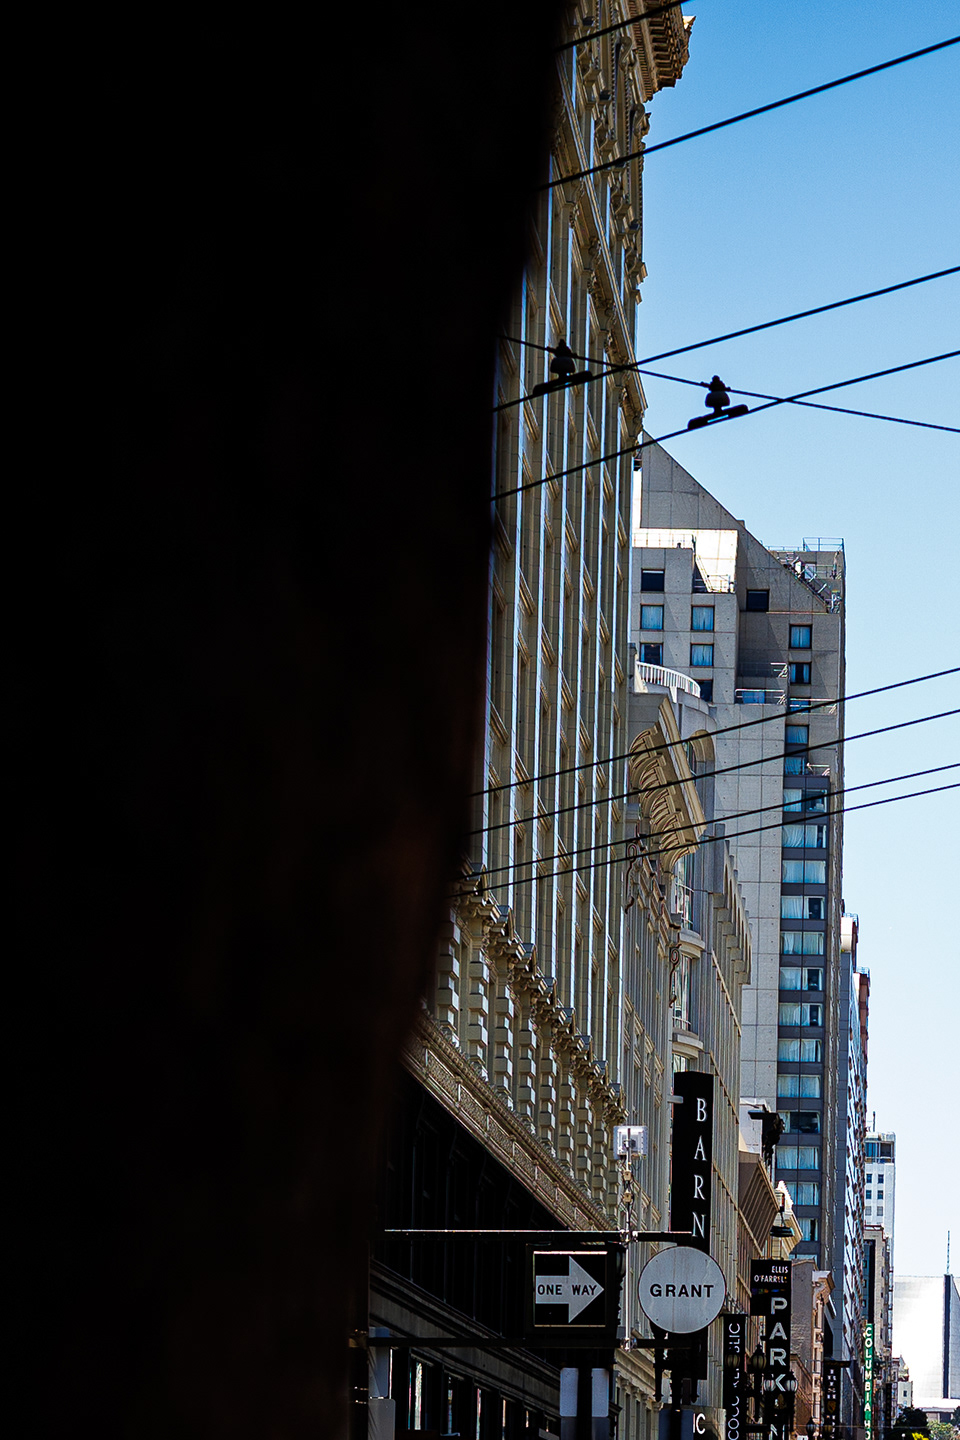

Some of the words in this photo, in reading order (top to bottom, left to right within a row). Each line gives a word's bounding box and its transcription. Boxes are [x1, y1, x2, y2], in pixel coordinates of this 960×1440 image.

[771, 1265, 788, 1274] ELLIS
[537, 1284, 562, 1296] ONE
[572, 1284, 597, 1296] WAY
[650, 1283, 714, 1298] GRANT
[864, 1327, 873, 1412] COLUMBIA
